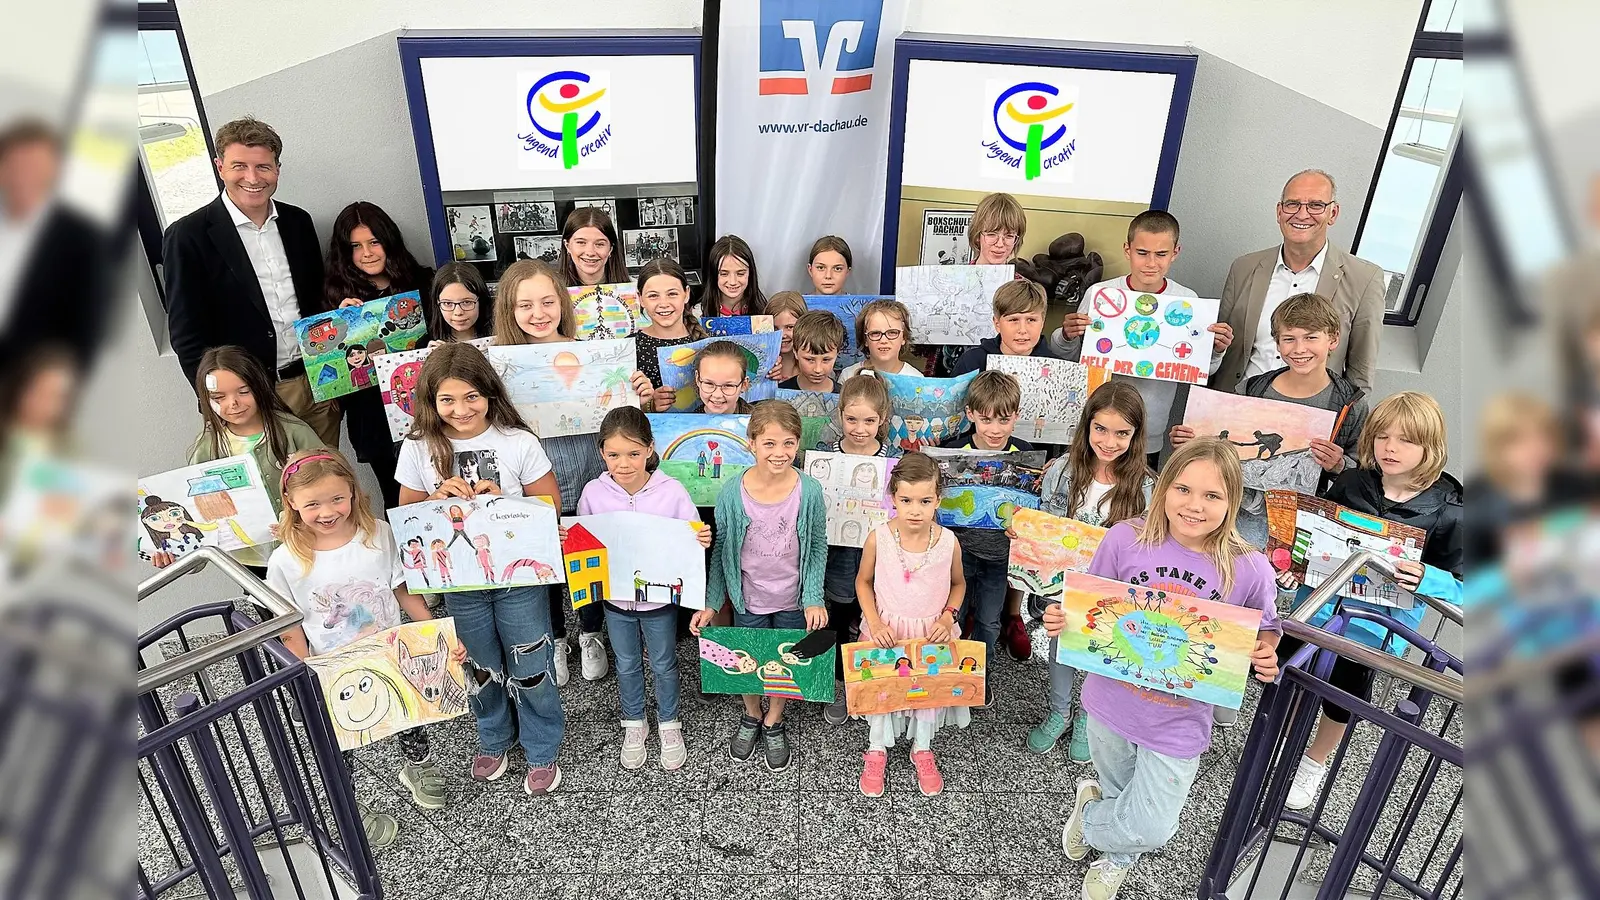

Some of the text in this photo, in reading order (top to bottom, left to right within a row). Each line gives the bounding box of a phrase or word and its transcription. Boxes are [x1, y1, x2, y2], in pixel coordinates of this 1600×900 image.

[758, 114, 869, 134] www.vr-dachau.de
[517, 123, 612, 159] jugend creativ
[981, 138, 1076, 170] jugend creativ
[933, 225, 965, 234] DACHAU
[1113, 360, 1134, 375] DER
[1156, 566, 1207, 591] TAKE
